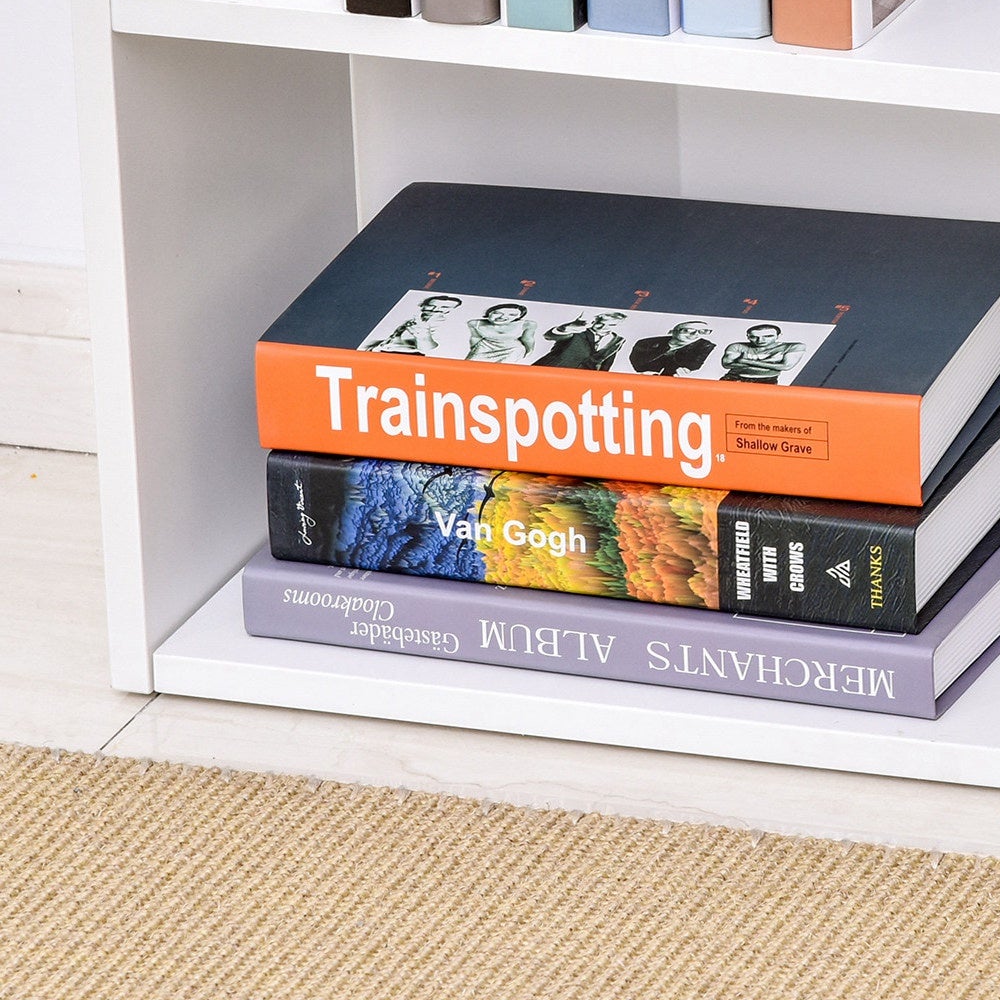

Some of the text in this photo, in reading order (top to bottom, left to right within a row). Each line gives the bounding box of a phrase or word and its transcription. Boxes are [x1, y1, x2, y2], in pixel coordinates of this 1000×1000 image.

[315, 364, 726, 480] Trainspotting 18
[735, 420, 812, 434] From the makers of
[736, 437, 812, 454] Shallow Grave
[433, 511, 587, 558] Van Gogh
[734, 520, 752, 600] WHEATFIELD
[762, 546, 778, 582] WITH
[789, 541, 805, 592] CROWS
[870, 545, 883, 609] THANKS
[283, 587, 395, 622] Cloakrooms
[350, 620, 460, 654] Gästebäder
[479, 618, 896, 699] MERCHANTS ALBUM
